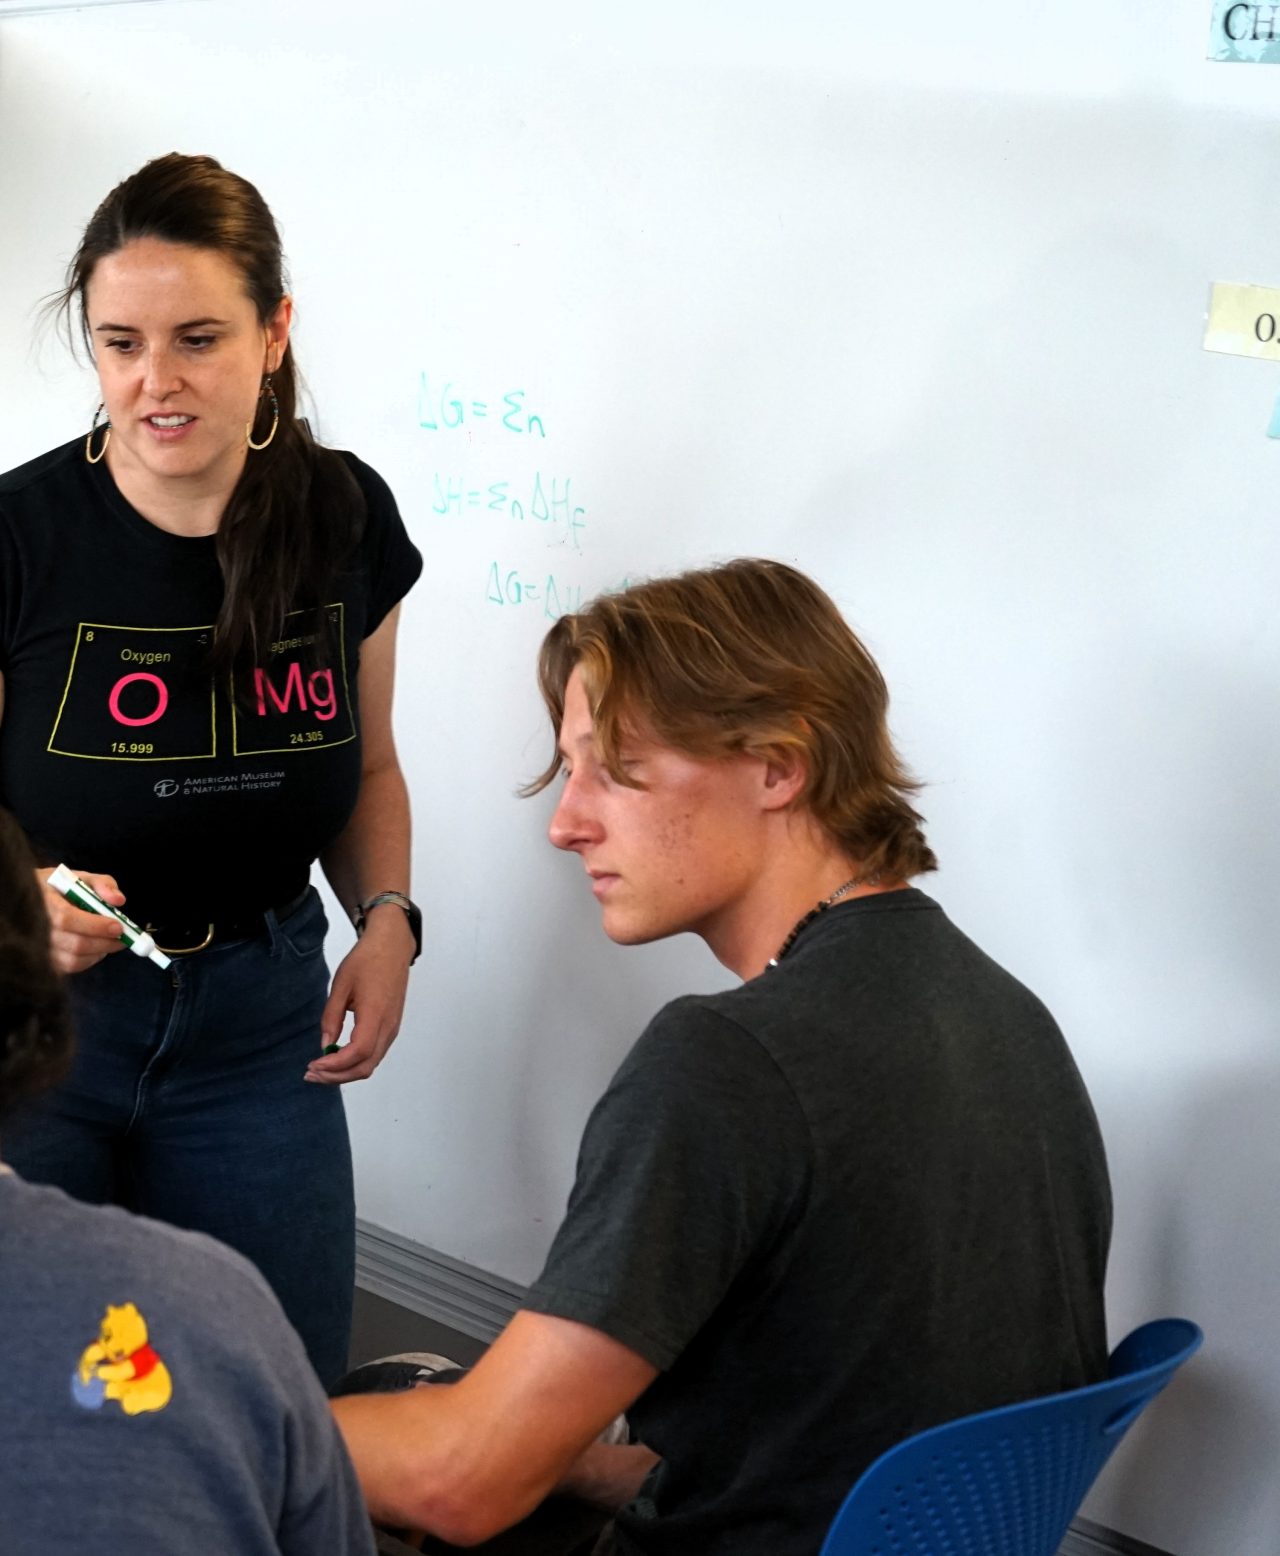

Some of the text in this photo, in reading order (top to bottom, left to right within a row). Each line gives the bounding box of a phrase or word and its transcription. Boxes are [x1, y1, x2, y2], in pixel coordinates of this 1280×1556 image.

[84, 630, 95, 642] 8
[120, 648, 171, 666] Oxygen
[108, 672, 169, 727] O
[253, 662, 338, 722] Mg
[289, 730, 325, 745] 24.305
[110, 742, 154, 755] 15.999
